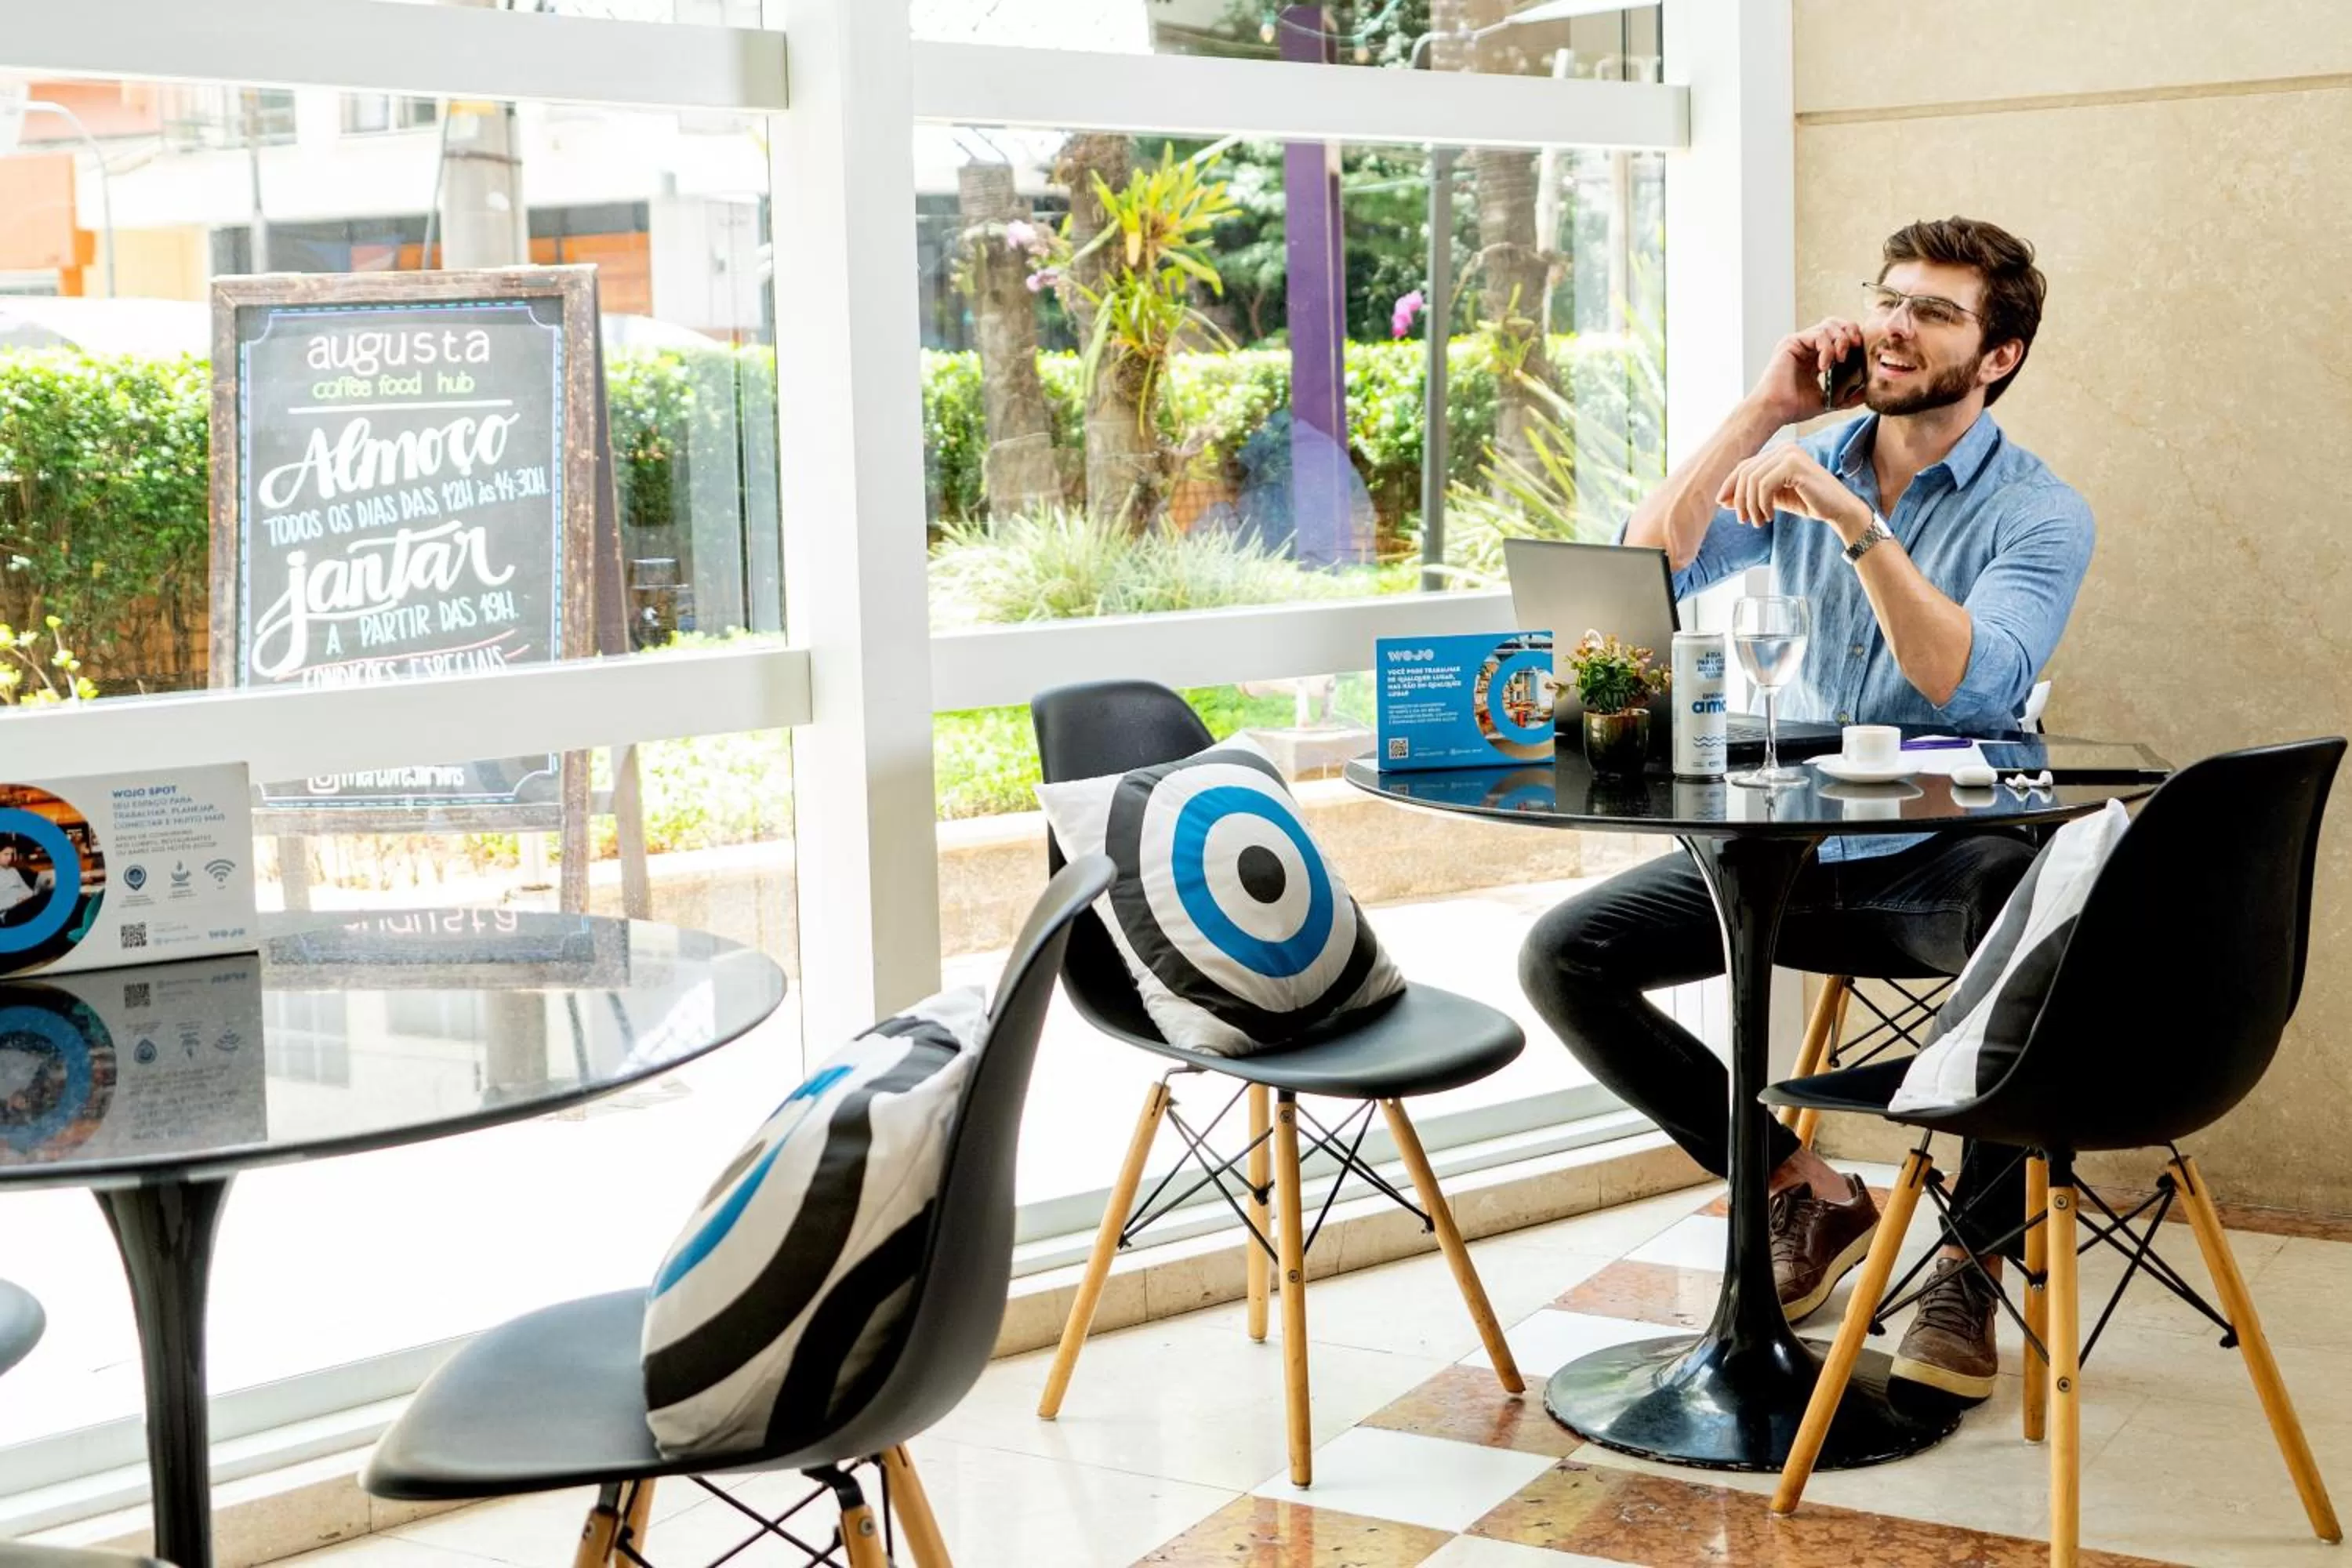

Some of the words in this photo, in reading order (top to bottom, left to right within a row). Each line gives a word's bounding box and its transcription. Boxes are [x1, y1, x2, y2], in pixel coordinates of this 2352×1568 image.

[307, 329, 490, 376] augusta
[313, 373, 372, 400] coffee
[379, 372, 421, 396] food
[437, 370, 474, 394] hub
[258, 412, 521, 509] Almoço
[263, 510, 323, 546] TODOS
[327, 503, 353, 534] OS
[357, 494, 395, 528] DIAS
[441, 476, 474, 512] 12H
[251, 521, 517, 677] jantar
[325, 624, 342, 656] A
[360, 605, 430, 646] PARTIR
[439, 597, 477, 631] DAS
[149, 785, 177, 795] SPOT
